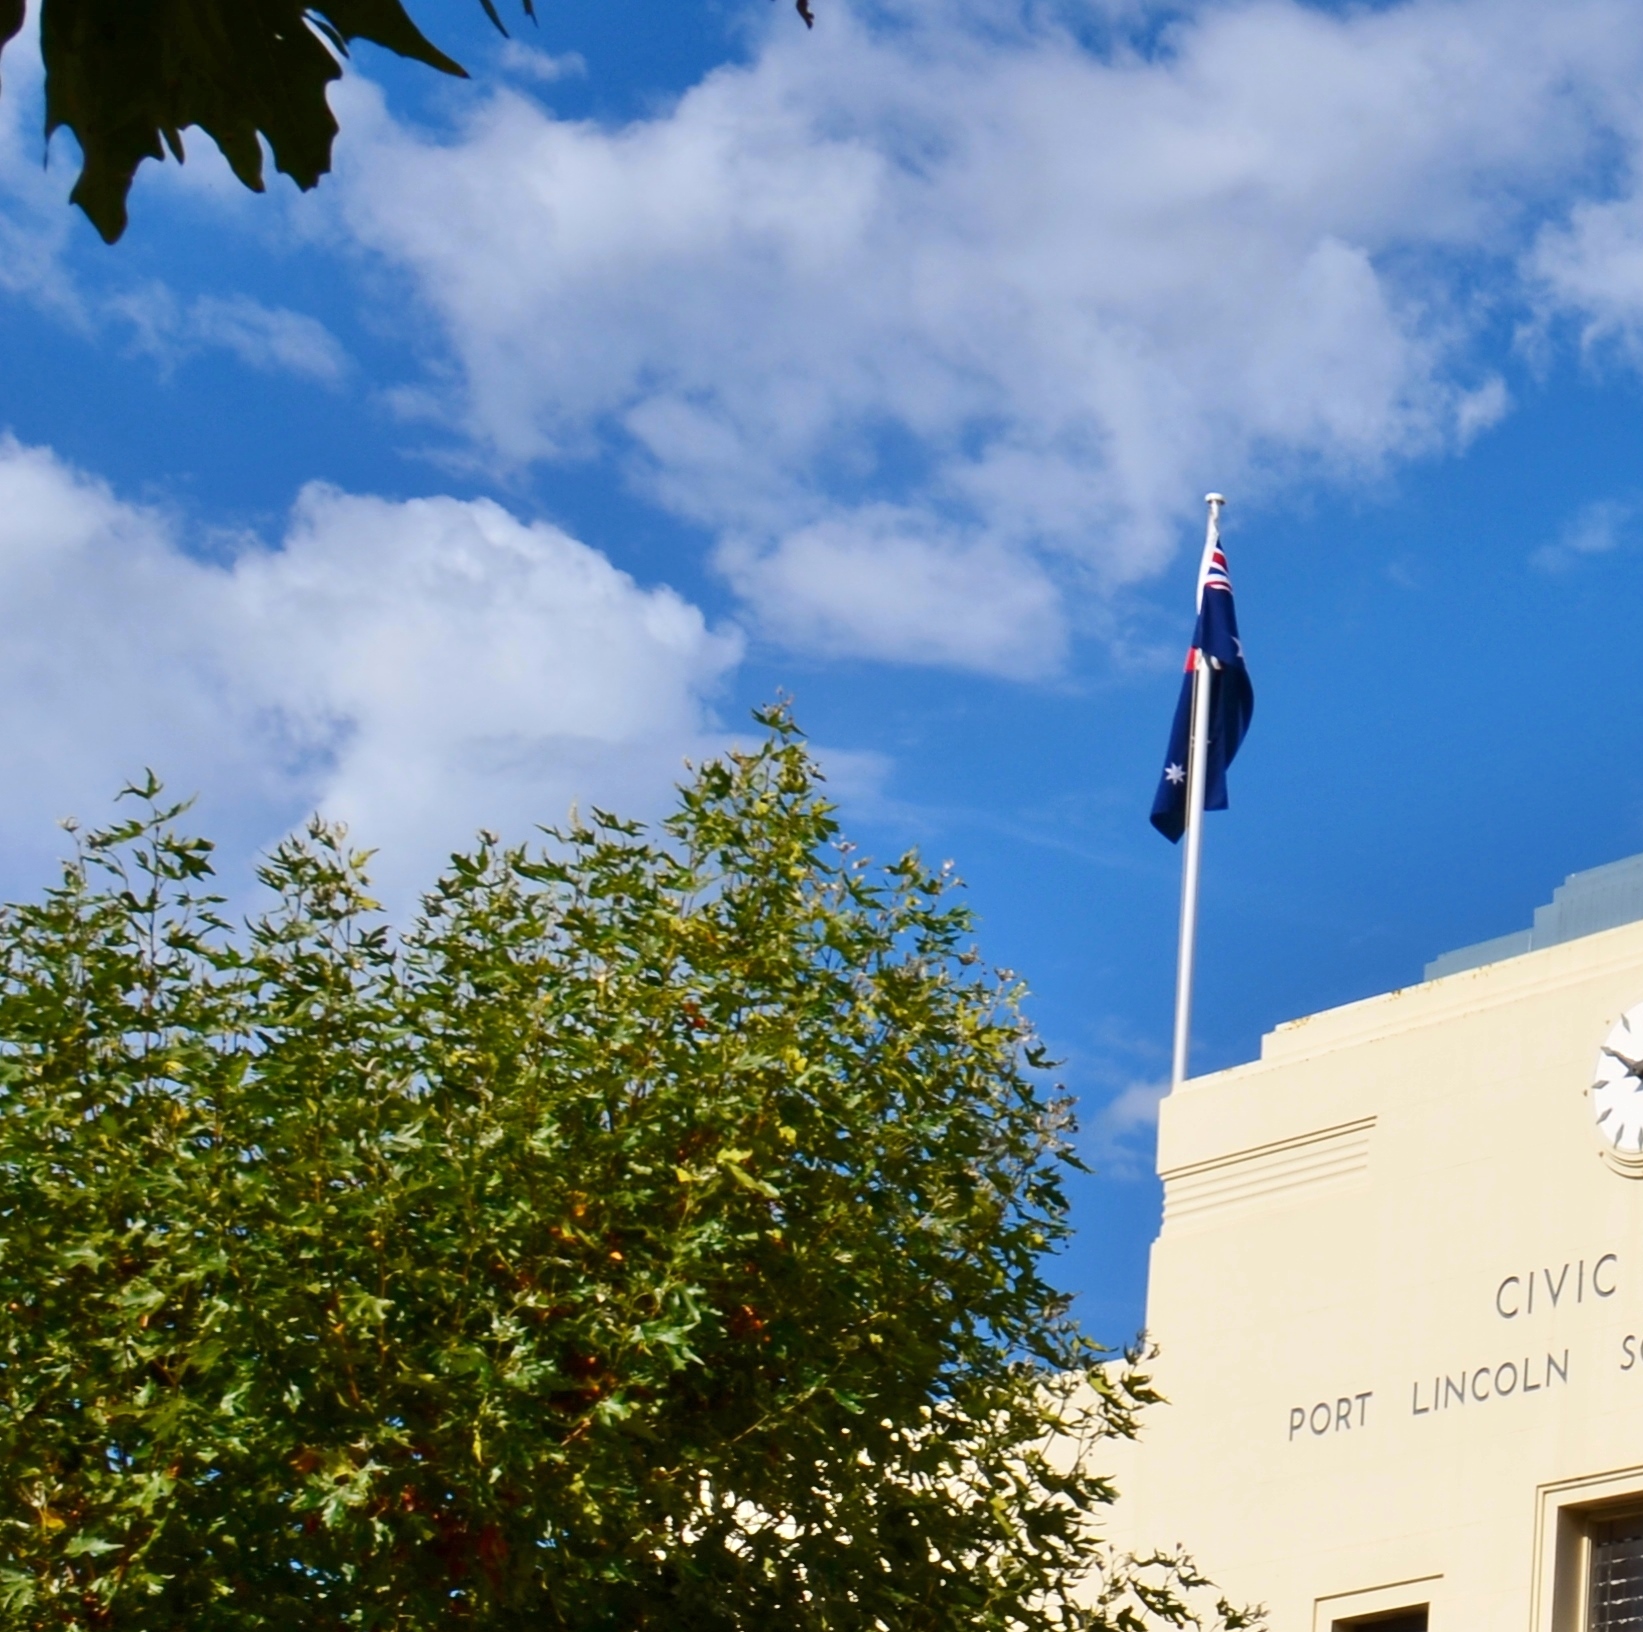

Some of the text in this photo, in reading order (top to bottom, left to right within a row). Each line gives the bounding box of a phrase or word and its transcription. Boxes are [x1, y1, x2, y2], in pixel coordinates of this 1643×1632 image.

[1495, 1252, 1618, 1320] CIVIC
[1288, 1390, 1374, 1443] PORT
[1411, 1348, 1570, 1417] LINCOLN
